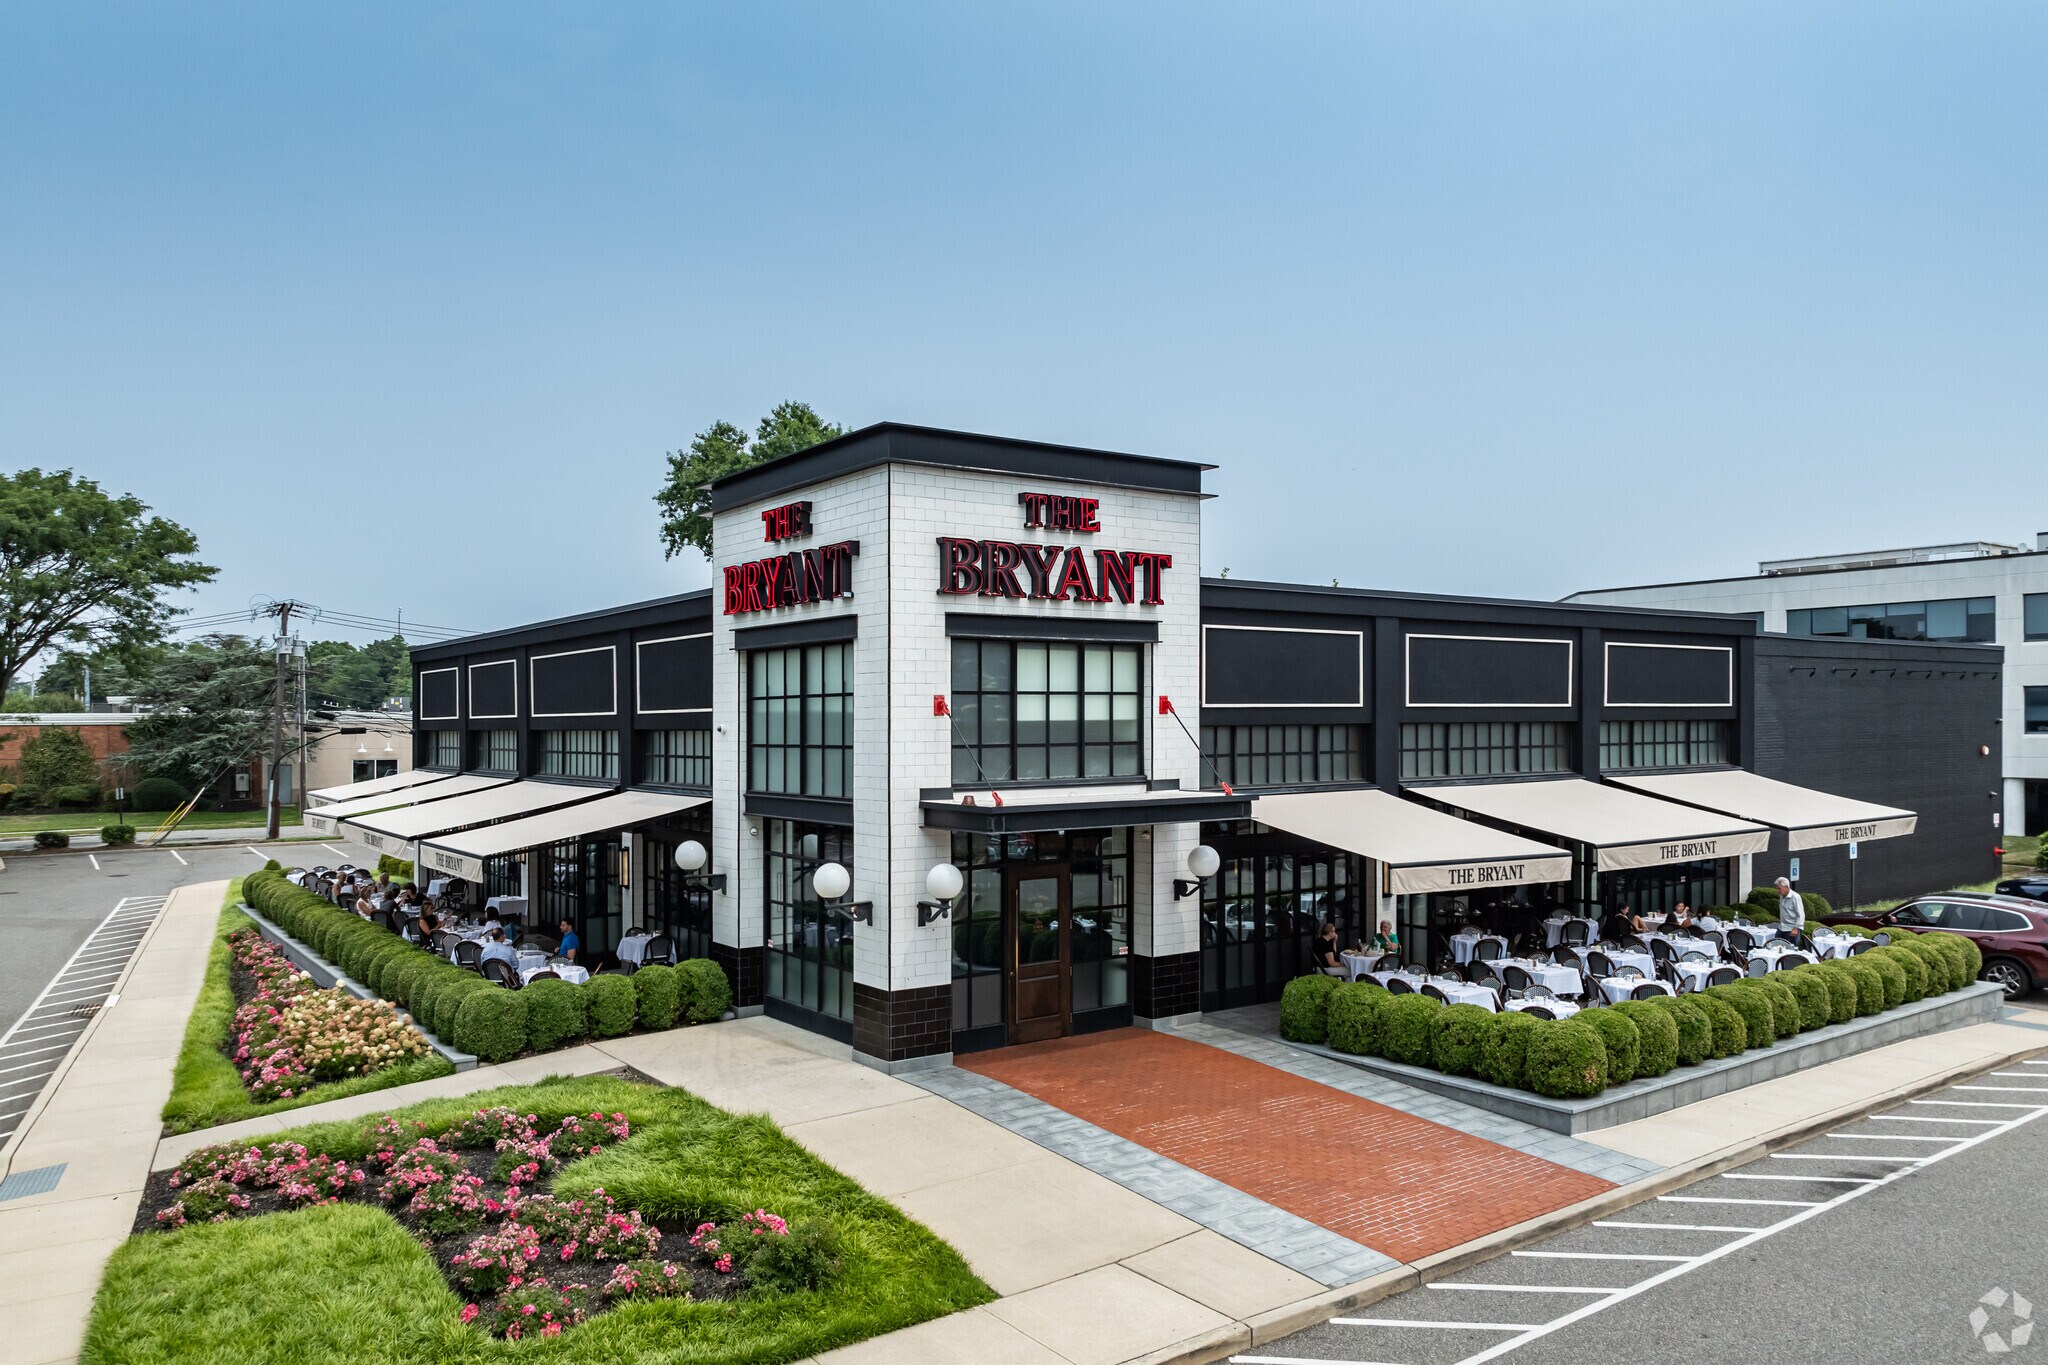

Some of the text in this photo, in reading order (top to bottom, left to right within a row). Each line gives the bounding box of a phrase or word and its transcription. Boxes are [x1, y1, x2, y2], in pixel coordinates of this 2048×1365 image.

[762, 501, 812, 541] THE
[1019, 492, 1100, 533] THE
[724, 540, 860, 615] BRYANT
[936, 537, 1172, 605] BRYANT
[1835, 825, 1877, 840] THE BRYANT
[435, 852, 445, 867] THE
[1660, 841, 1717, 859] THE BRYANT
[1448, 865, 1525, 885] THE BRYANT
